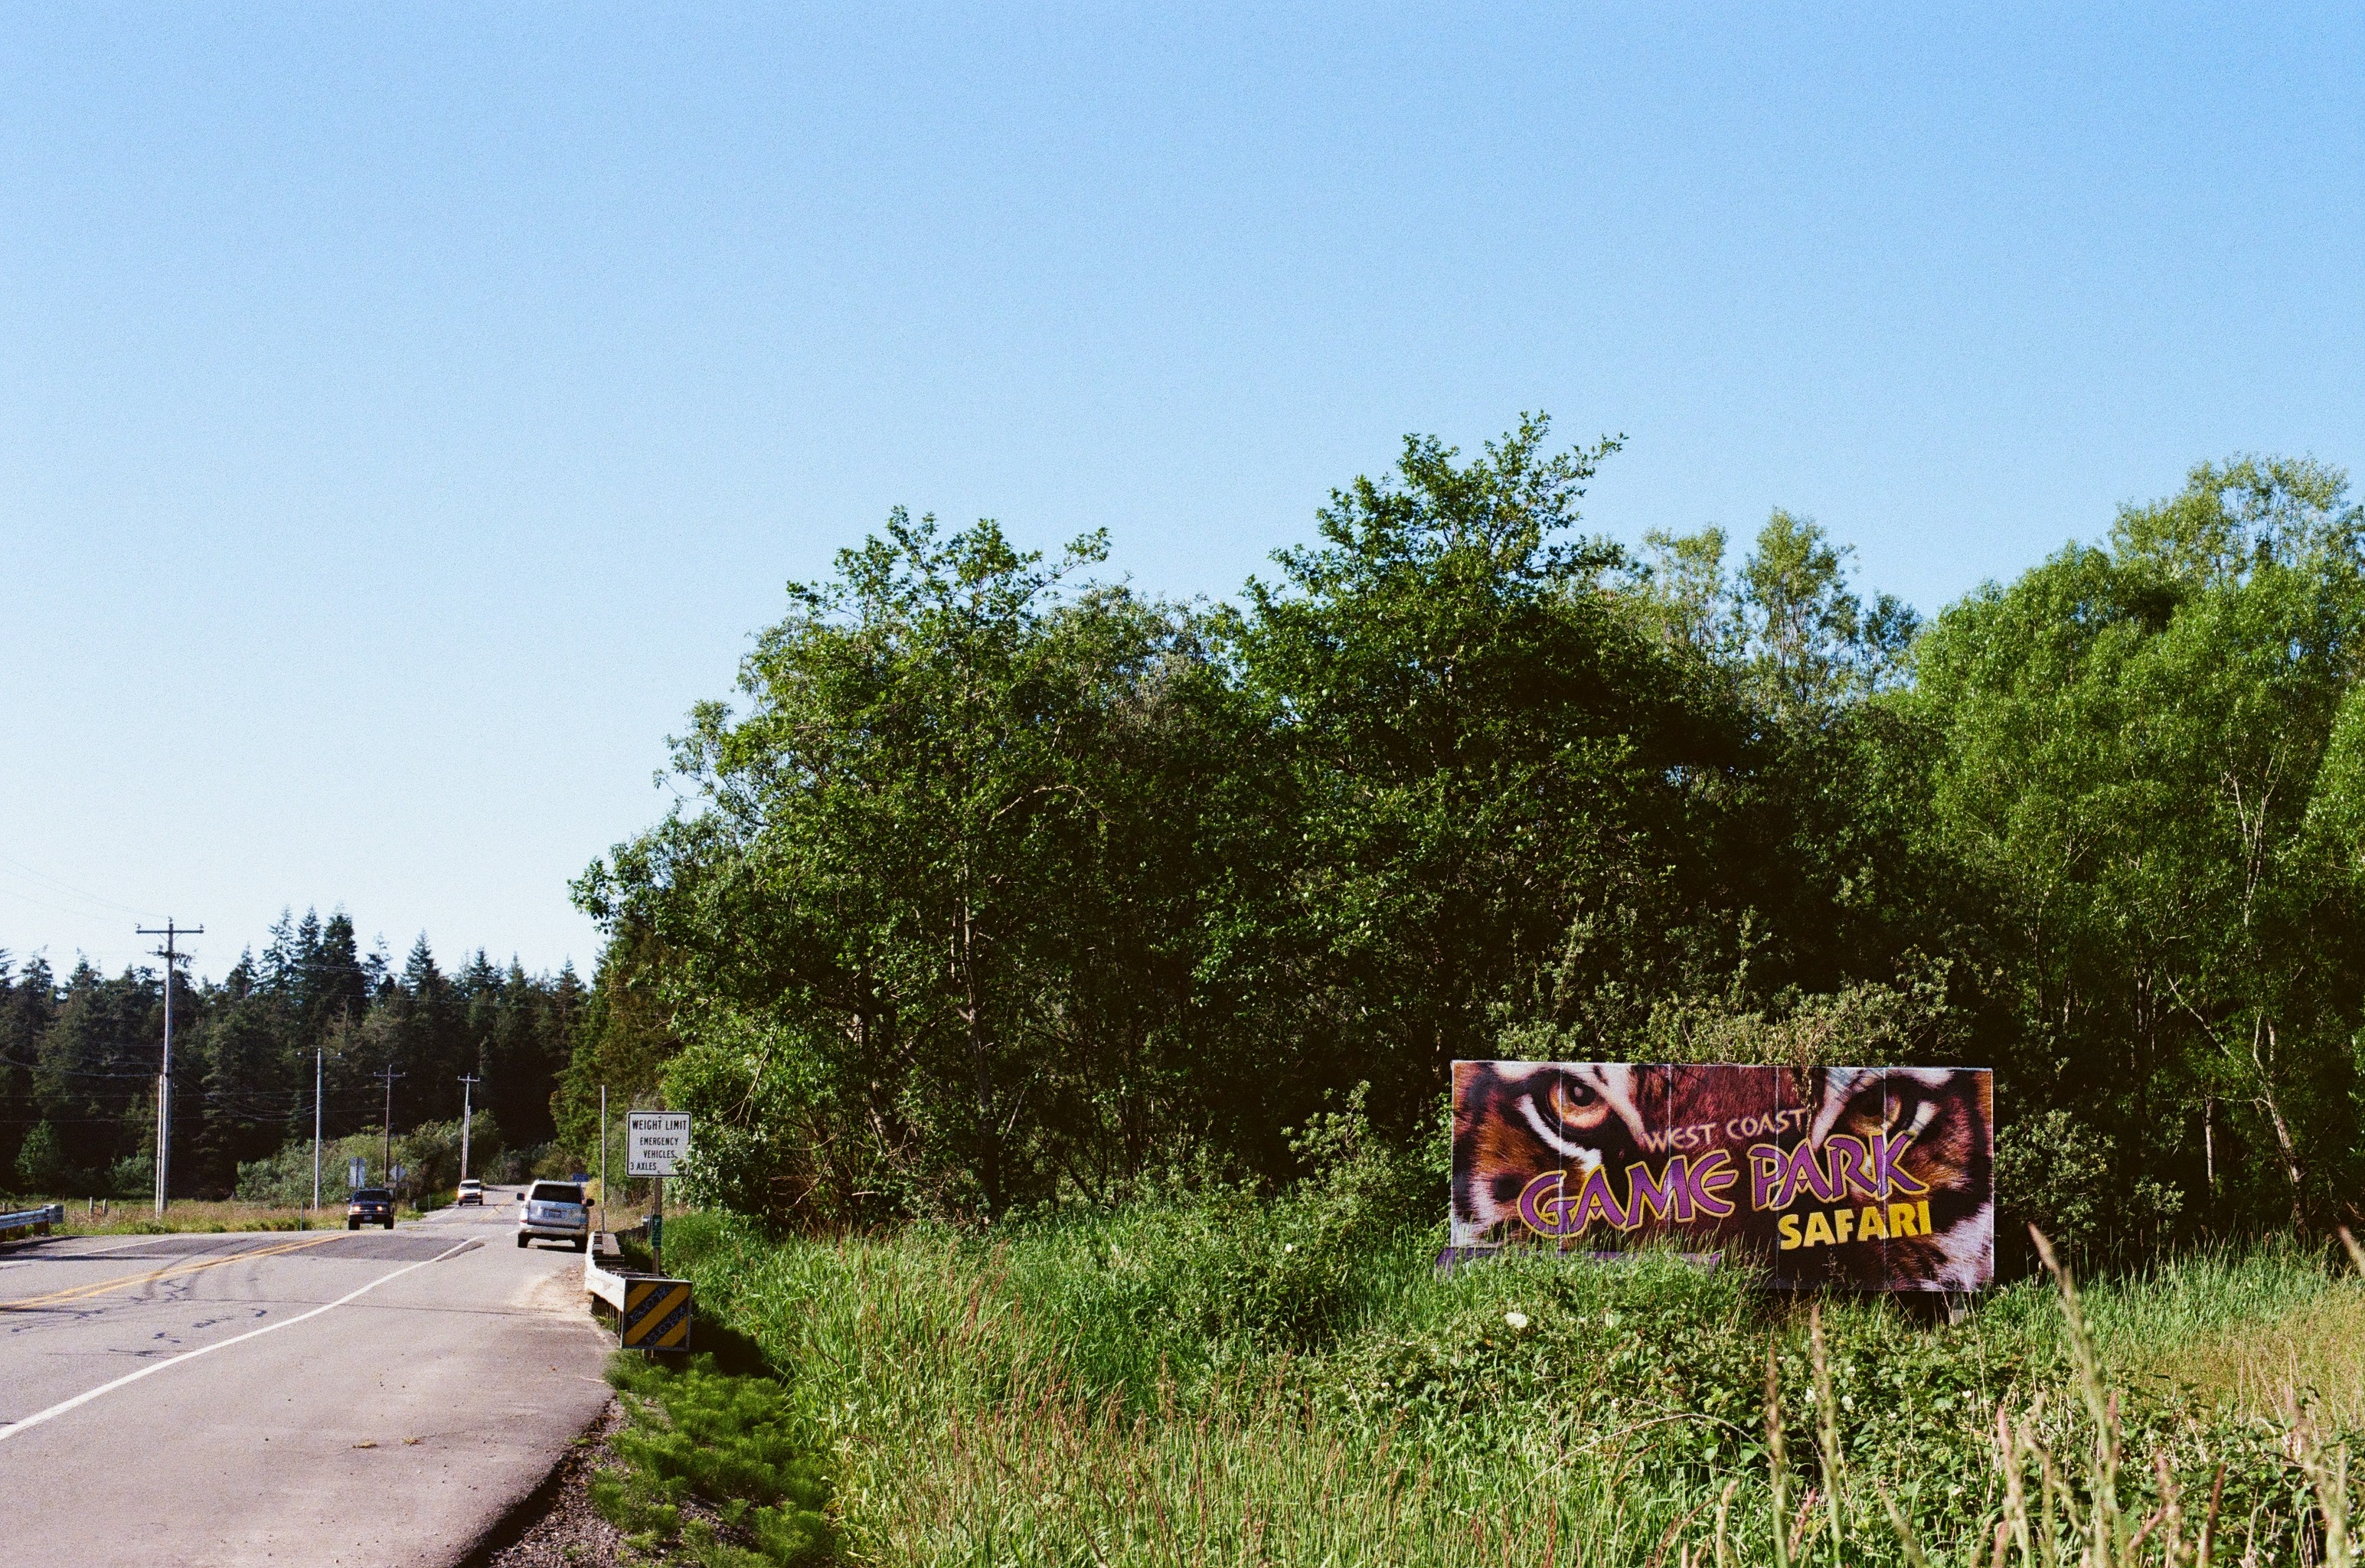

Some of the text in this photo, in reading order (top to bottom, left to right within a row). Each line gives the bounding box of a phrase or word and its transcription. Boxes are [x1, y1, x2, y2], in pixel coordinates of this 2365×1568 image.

[632, 1120, 687, 1130] WEIGHT LIMIT
[1638, 1109, 1807, 1152] WEST COAST
[640, 1137, 679, 1145] EMERGENCY
[643, 1150, 675, 1158] VEHICLES
[1517, 1129, 1930, 1239] GAME PARK
[1778, 1199, 1932, 1250] SAFARI
